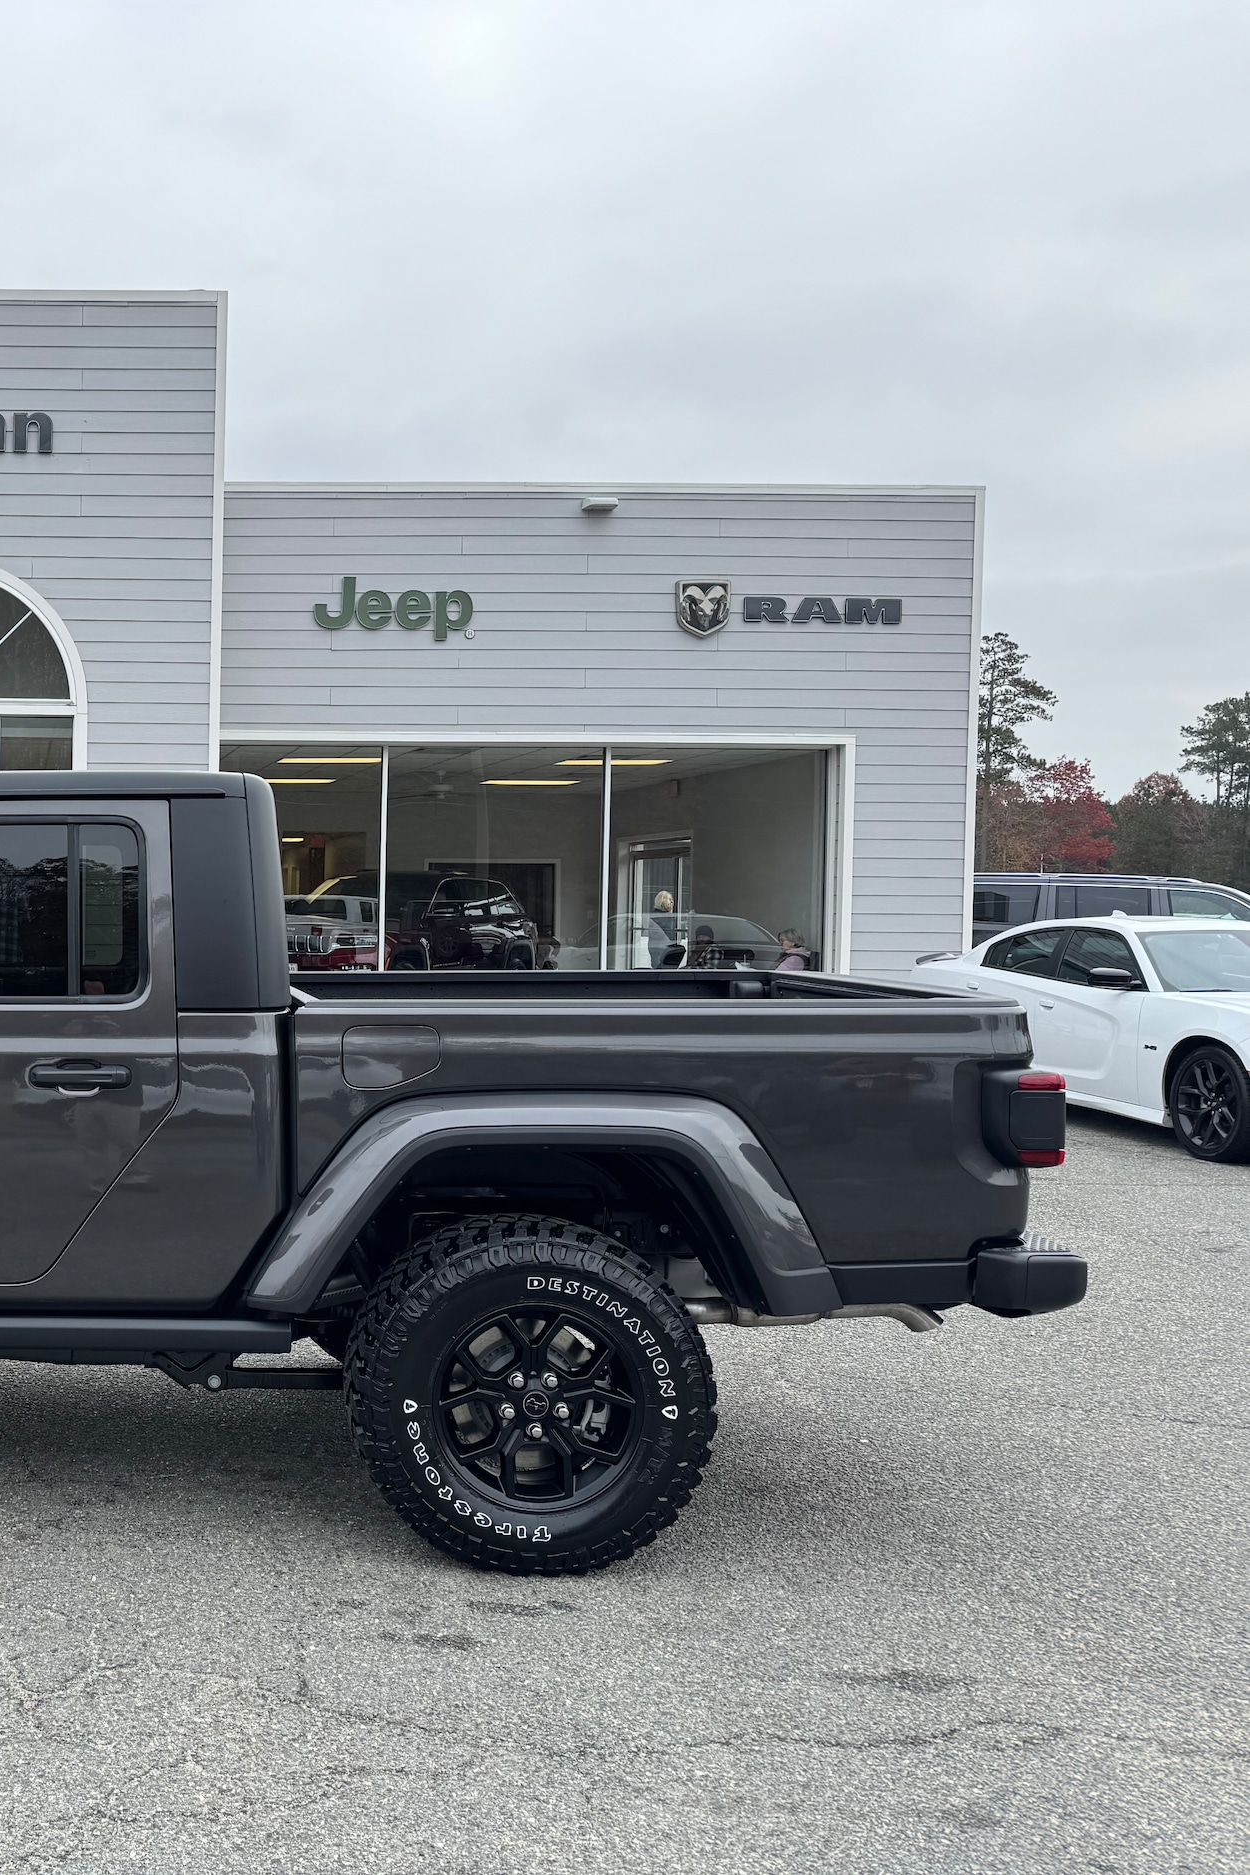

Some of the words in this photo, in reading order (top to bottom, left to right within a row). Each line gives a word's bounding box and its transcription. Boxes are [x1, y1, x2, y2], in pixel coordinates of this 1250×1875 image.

[313, 576, 474, 641] Jeep
[743, 596, 902, 624] RAM
[526, 1276, 676, 1398] DESTINATION
